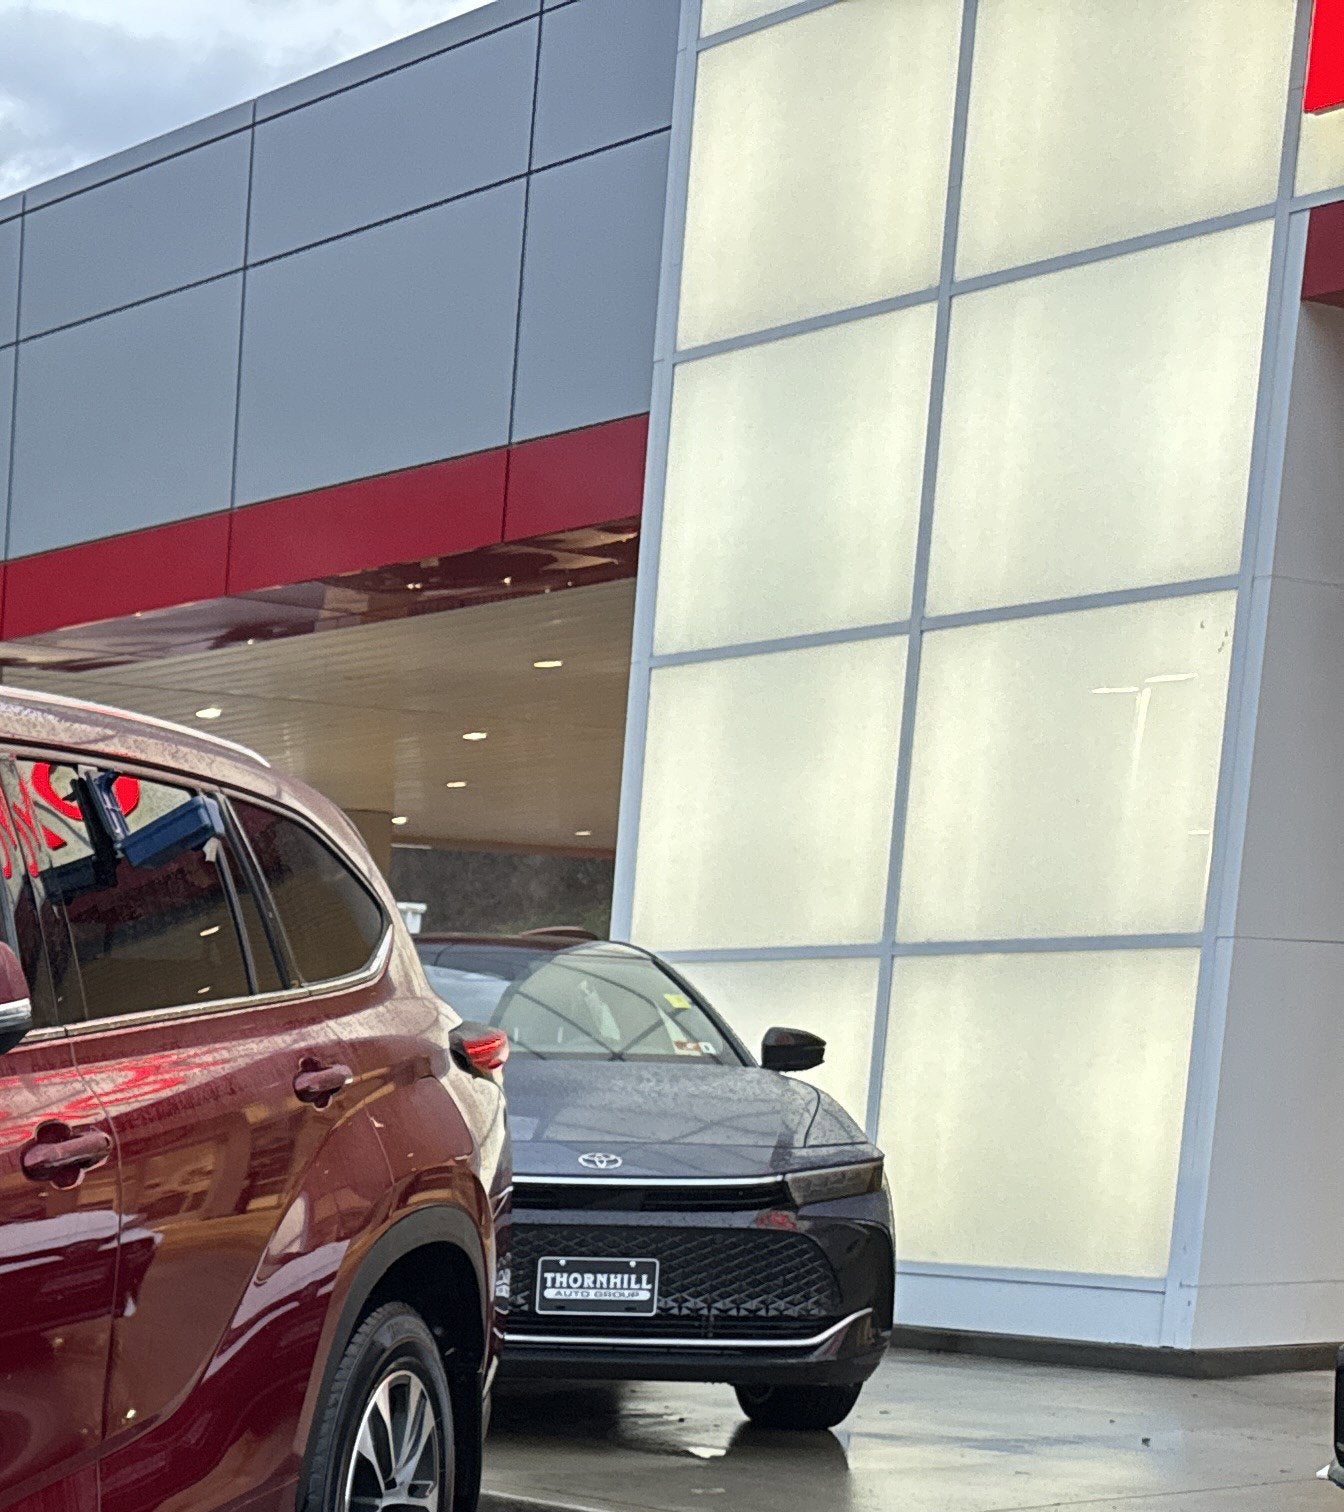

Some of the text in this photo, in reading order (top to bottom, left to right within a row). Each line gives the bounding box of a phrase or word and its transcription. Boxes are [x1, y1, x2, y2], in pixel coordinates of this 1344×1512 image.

[543, 1272, 652, 1290] THORNHILL
[554, 1290, 640, 1299] AUTO GROUP
